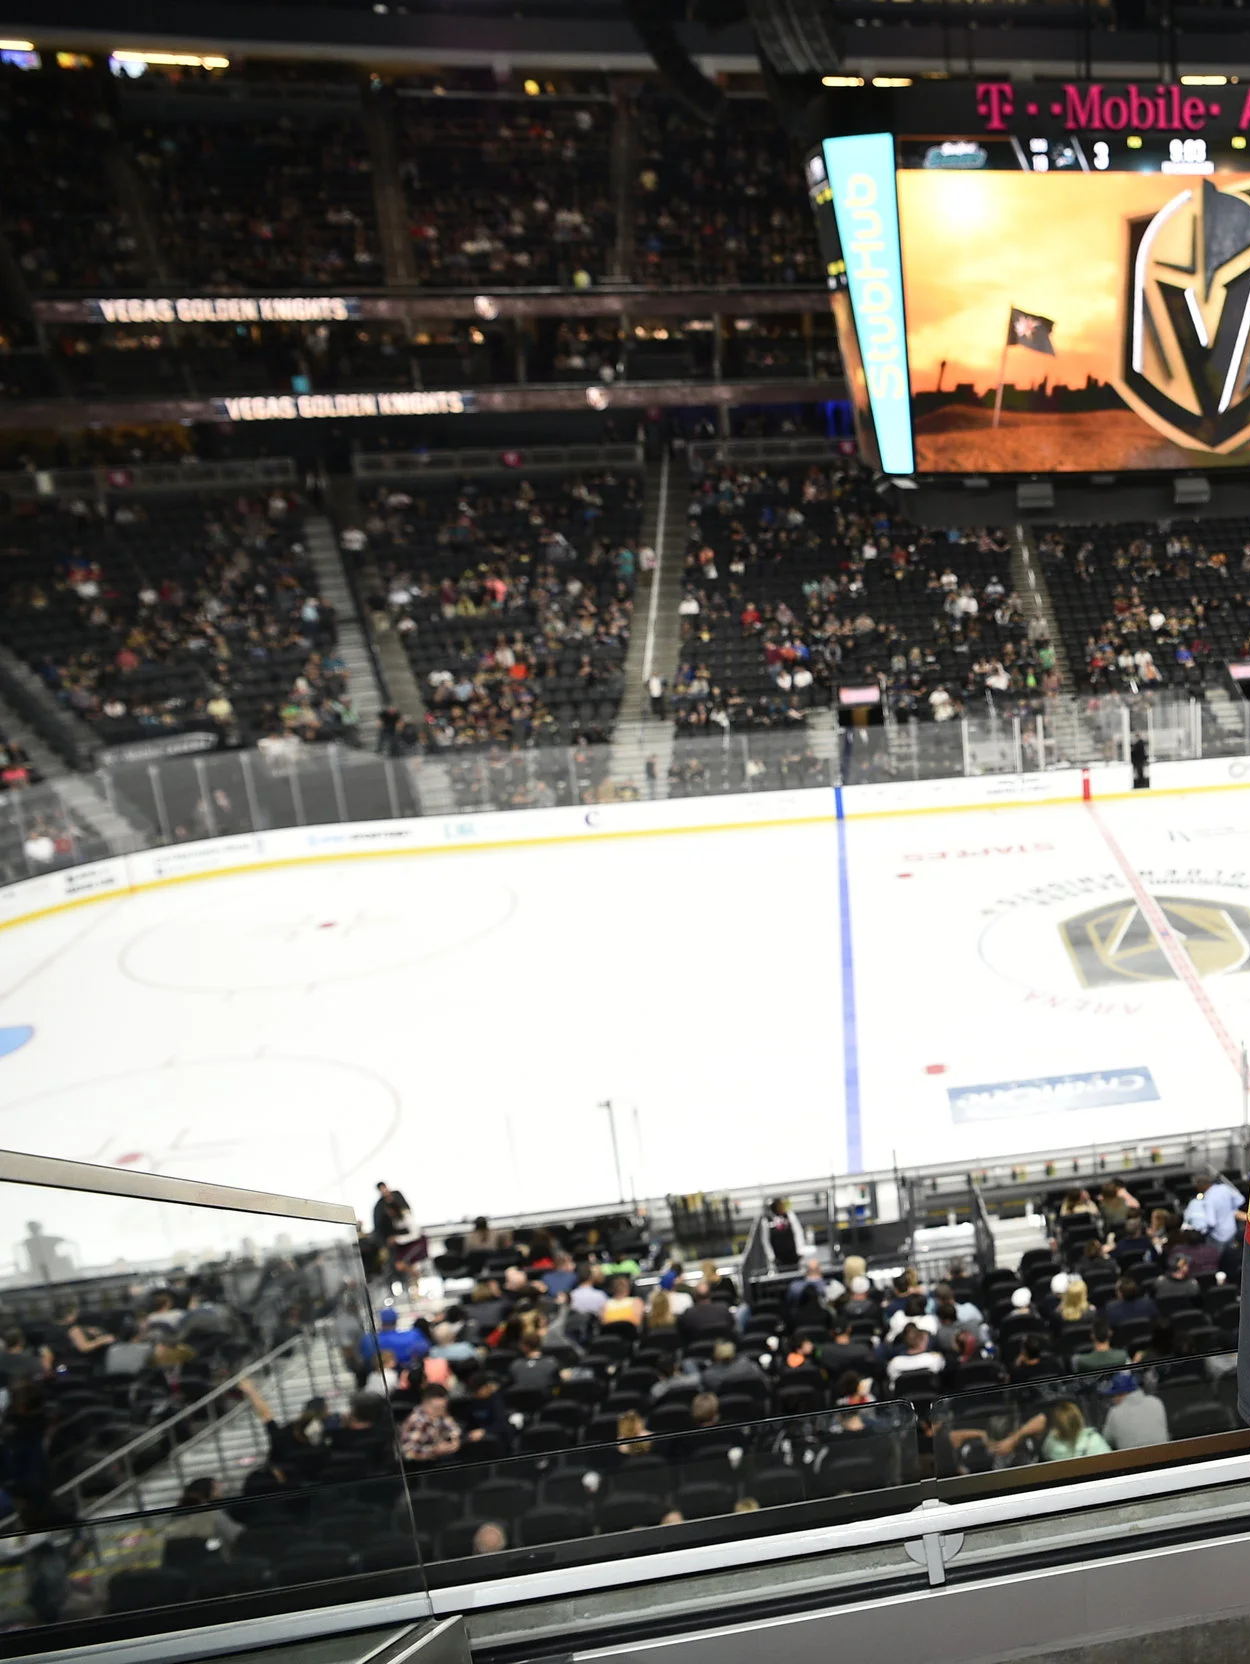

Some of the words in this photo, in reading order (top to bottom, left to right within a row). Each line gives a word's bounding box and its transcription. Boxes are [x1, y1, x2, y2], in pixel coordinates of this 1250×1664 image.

[844, 172, 906, 400] StubHub
[99, 298, 176, 323] VEGAS
[175, 298, 259, 322] GOLDEN
[258, 297, 349, 321] KNIGHTS
[224, 396, 298, 421] VEGAS
[297, 394, 378, 418] GOLDEN
[377, 391, 465, 416] KNIGHTS
